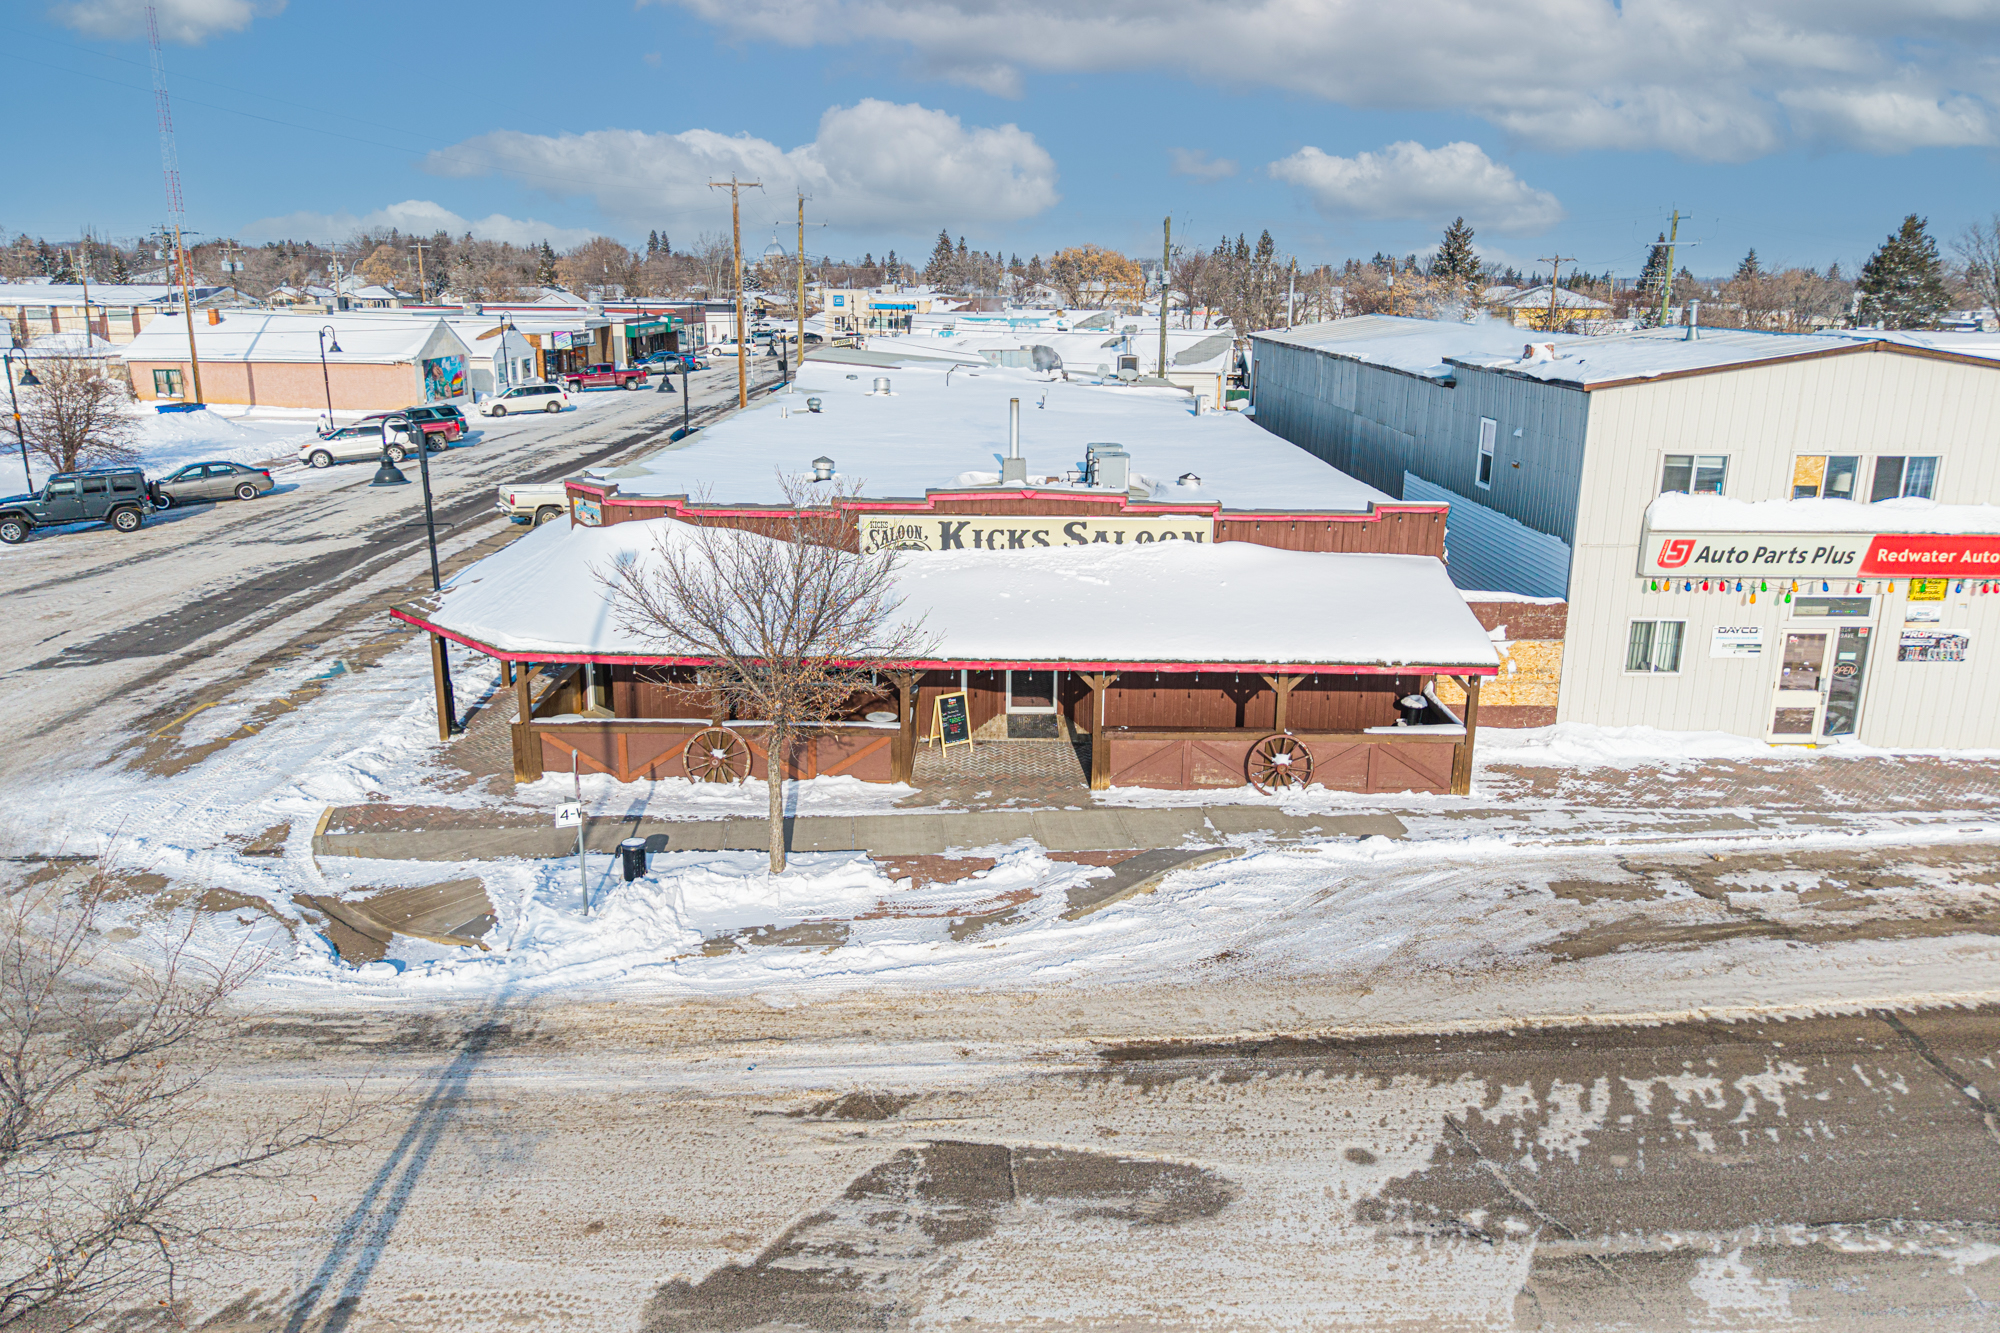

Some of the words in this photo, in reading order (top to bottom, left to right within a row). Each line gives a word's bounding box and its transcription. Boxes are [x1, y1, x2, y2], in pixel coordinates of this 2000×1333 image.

[869, 521, 889, 529] KICKS
[938, 521, 1050, 551] KICKS
[1694, 545, 1749, 564] Auto
[1752, 546, 1808, 564] Parts
[1811, 545, 1856, 564] Plus
[1877, 548, 1957, 563] Redwater
[1960, 549, 2000, 563] Auto
[1718, 626, 1758, 634] DAYCO
[1834, 666, 1856, 675] OPEN
